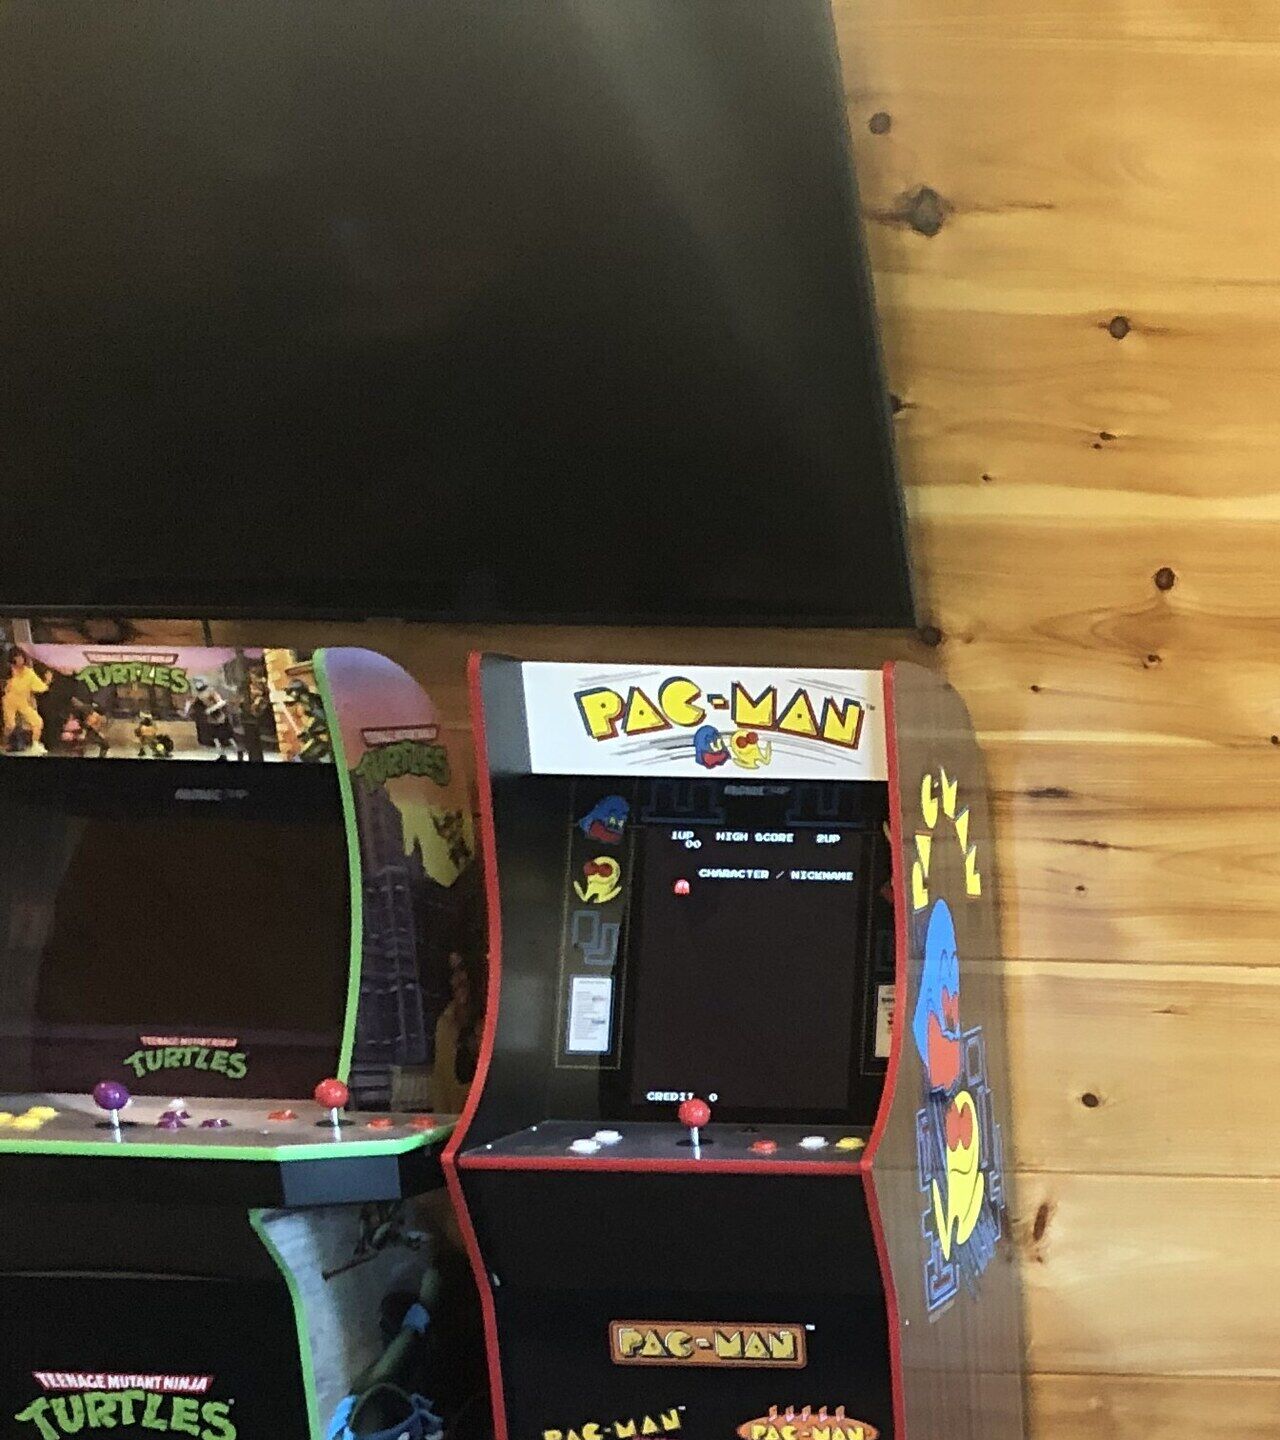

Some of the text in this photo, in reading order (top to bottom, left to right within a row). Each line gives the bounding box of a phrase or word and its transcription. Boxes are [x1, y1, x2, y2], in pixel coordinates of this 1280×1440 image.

[76, 662, 190, 694] TURTLES
[574, 676, 864, 750] PAC-MAN
[716, 832, 748, 842] HIGH
[755, 833, 794, 843] SCORE
[698, 868, 770, 880] CHARACTER
[123, 1046, 247, 1079] TURTLES
[646, 1091, 695, 1102] CREDIT
[618, 1327, 797, 1360] PAC-MAN
[34, 1372, 208, 1391] TEENAGE MUTANT NINJA
